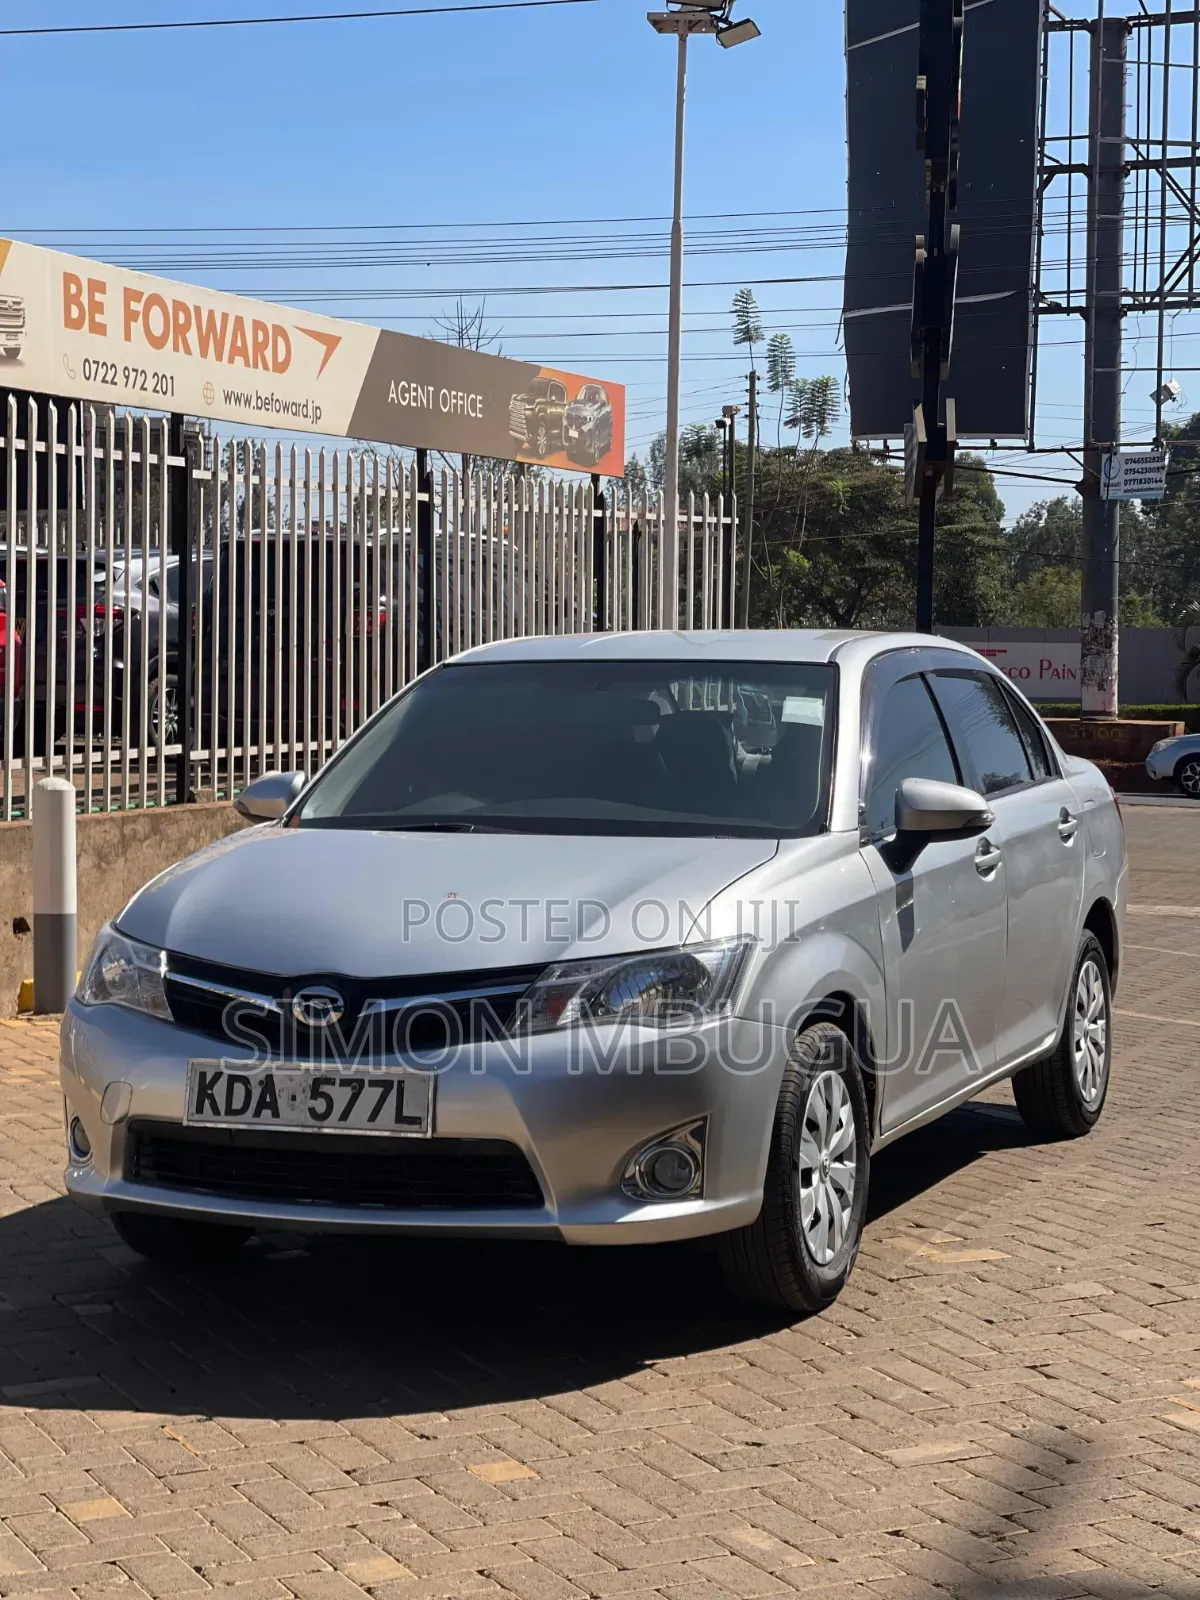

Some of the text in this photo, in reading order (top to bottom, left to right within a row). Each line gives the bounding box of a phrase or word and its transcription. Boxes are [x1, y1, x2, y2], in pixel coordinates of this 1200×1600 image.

[63, 271, 292, 374] BE FORWARD
[83, 358, 175, 397] 0722 972 201
[223, 387, 322, 424] www.befoward.jp
[388, 380, 483, 418] AGENT OFFICE
[1123, 466, 1163, 475] 075423005
[195, 1071, 423, 1127] KDA 577L
